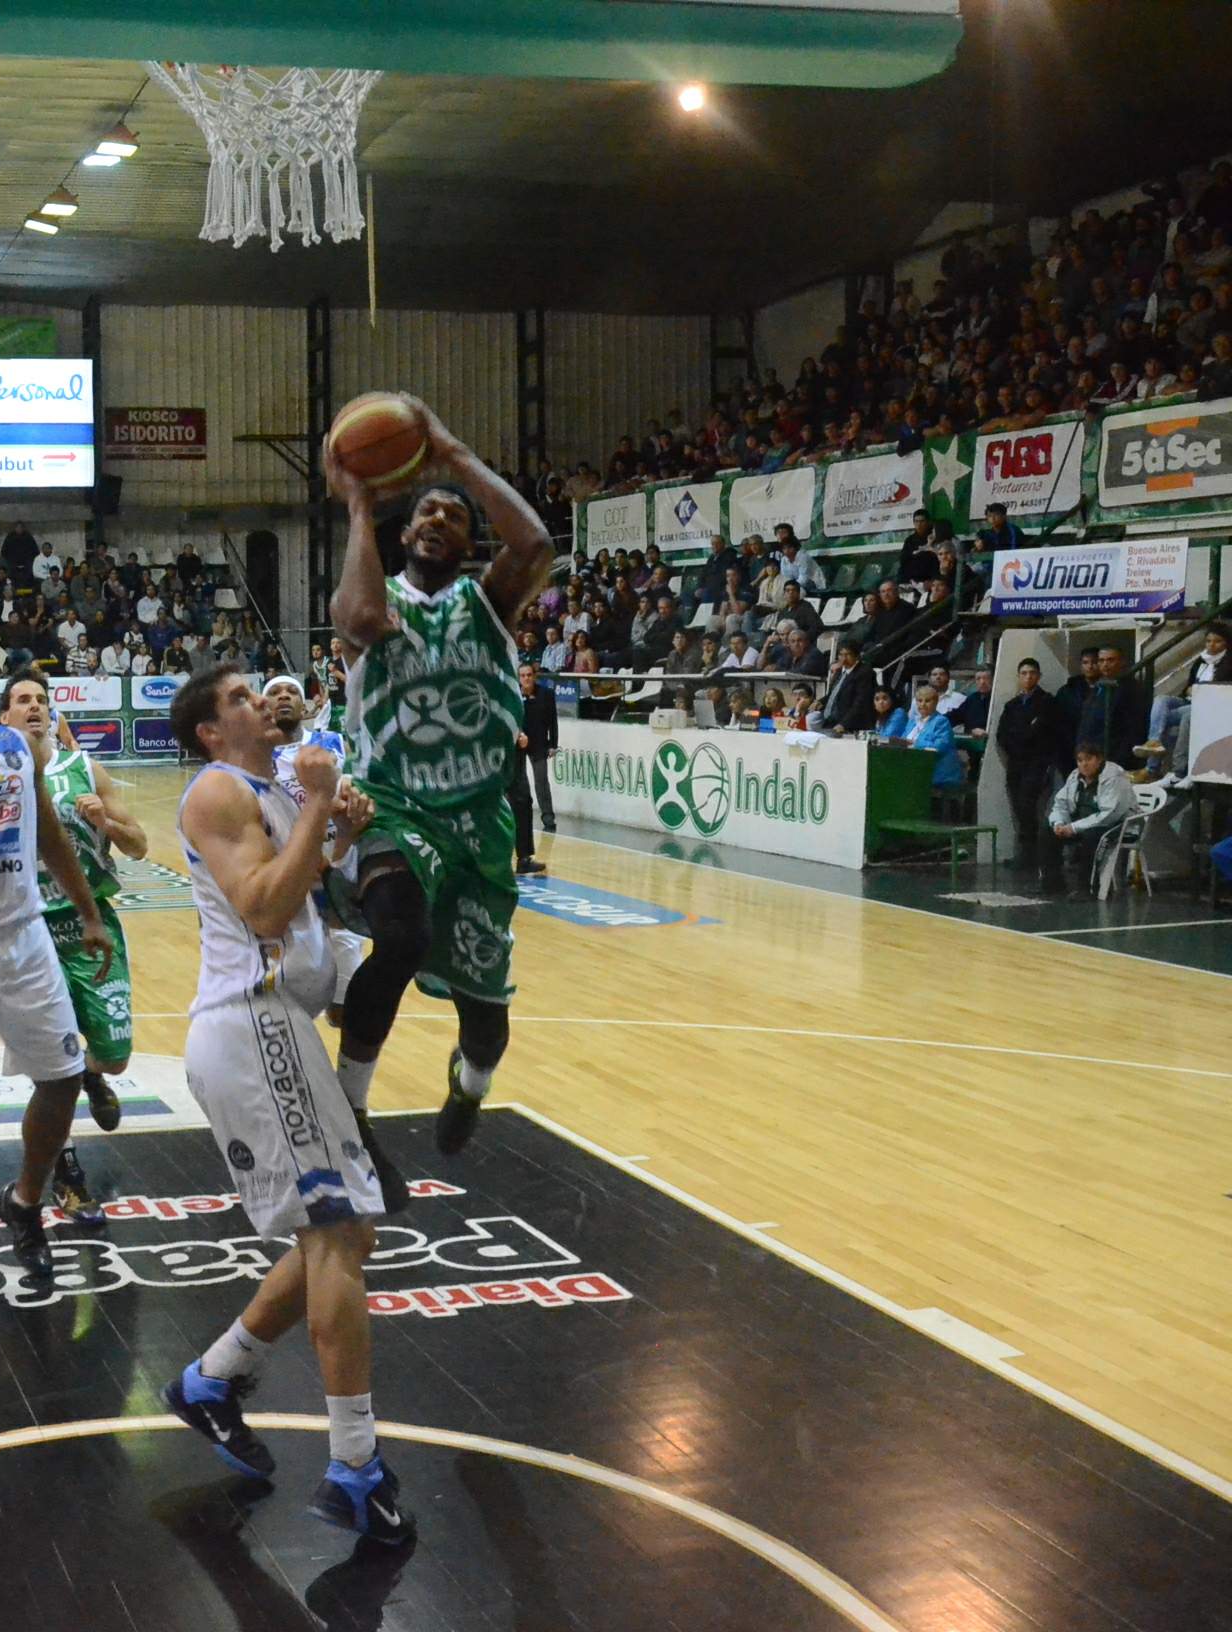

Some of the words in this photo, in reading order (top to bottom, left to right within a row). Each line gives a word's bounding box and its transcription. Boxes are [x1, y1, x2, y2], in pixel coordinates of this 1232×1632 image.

[113, 425, 197, 442] ISIDORITO
[128, 410, 179, 422] KIOSCO
[1002, 596, 1139, 612] www.transportesunion.com.ar
[138, 737, 166, 748] Banco
[399, 742, 506, 792] Indalo
[551, 747, 649, 798] GIMNASIA
[734, 757, 829, 825] Indalo
[258, 1011, 311, 1147] novacorp
[367, 1272, 634, 1319] Diario
